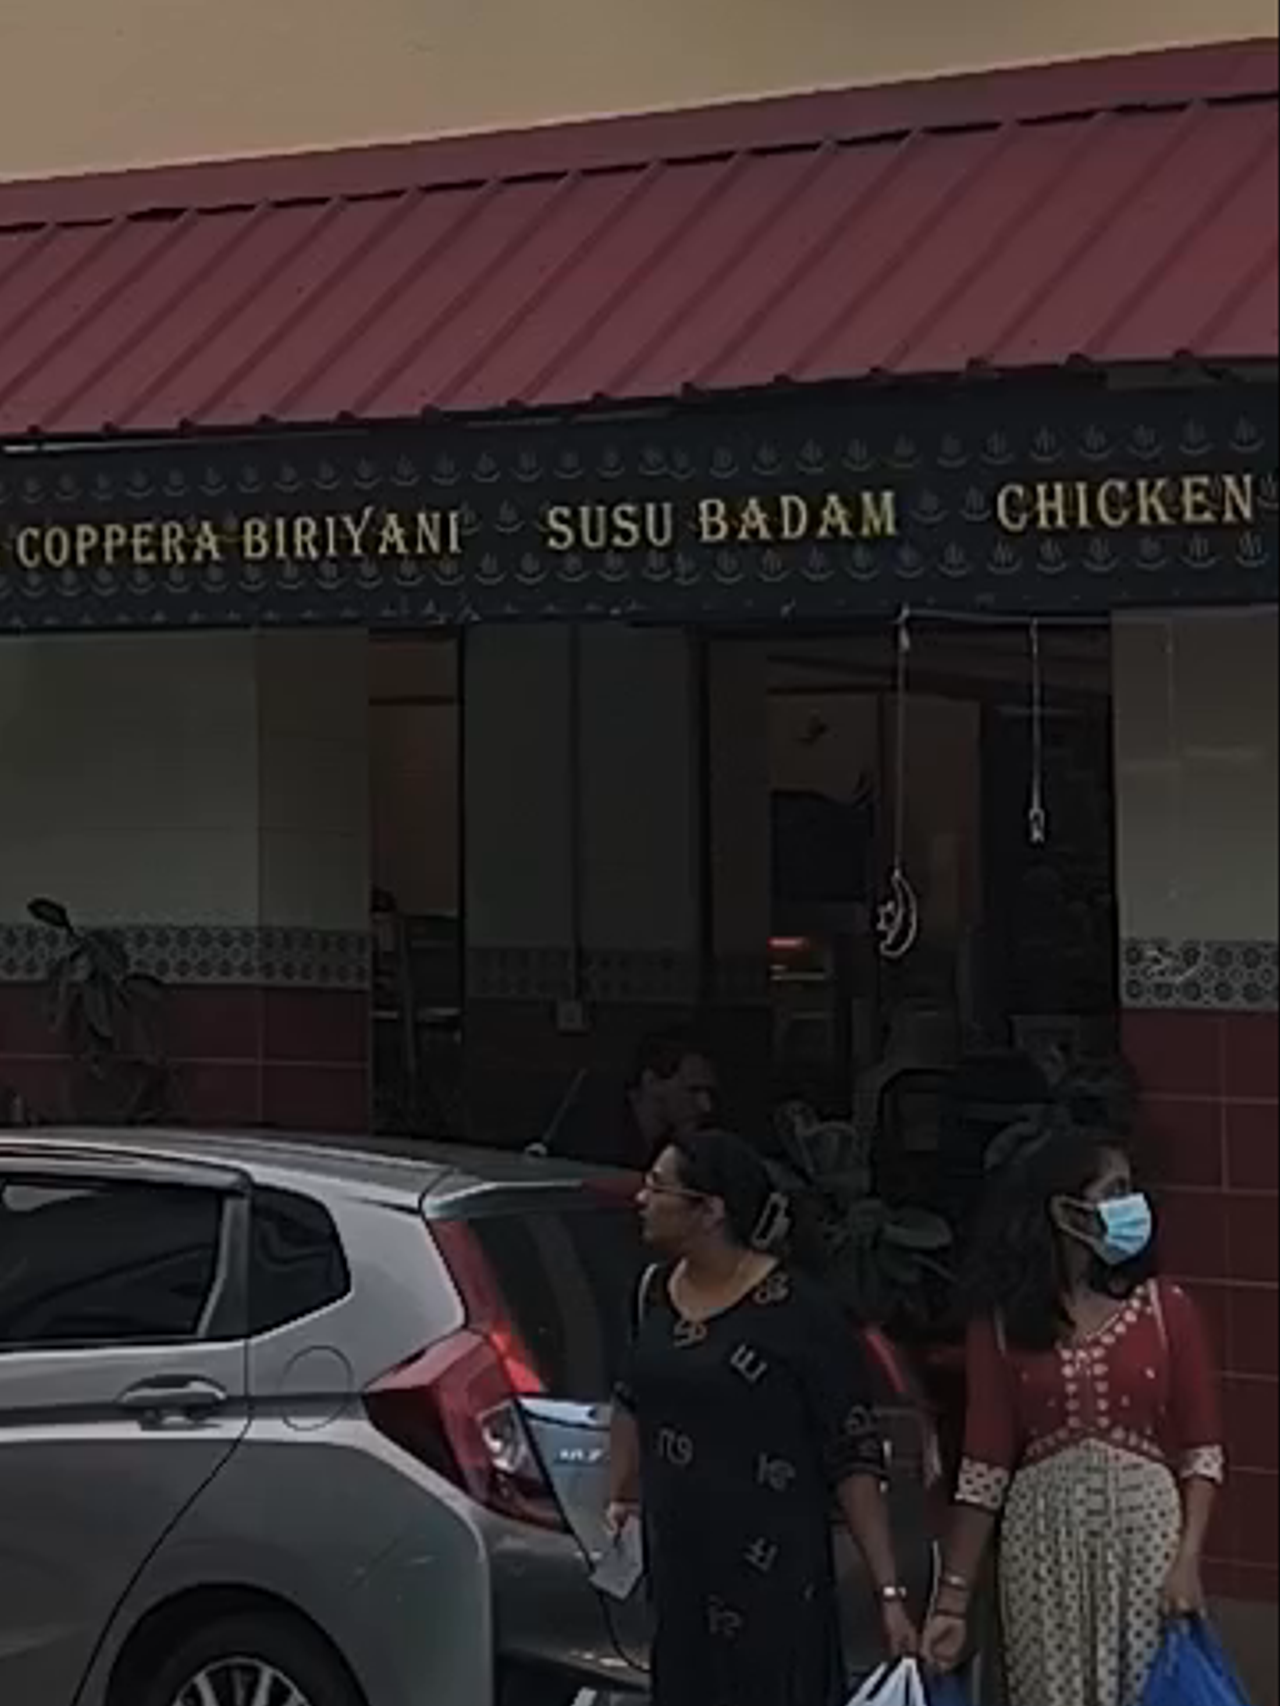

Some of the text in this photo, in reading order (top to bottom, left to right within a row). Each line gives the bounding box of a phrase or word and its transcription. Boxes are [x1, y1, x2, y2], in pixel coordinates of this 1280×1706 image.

[546, 489, 898, 550] SUSU BADAM
[995, 474, 1255, 533] CHICKEN
[17, 520, 222, 568] COPPERA
[241, 506, 462, 560] BIRIYANI
